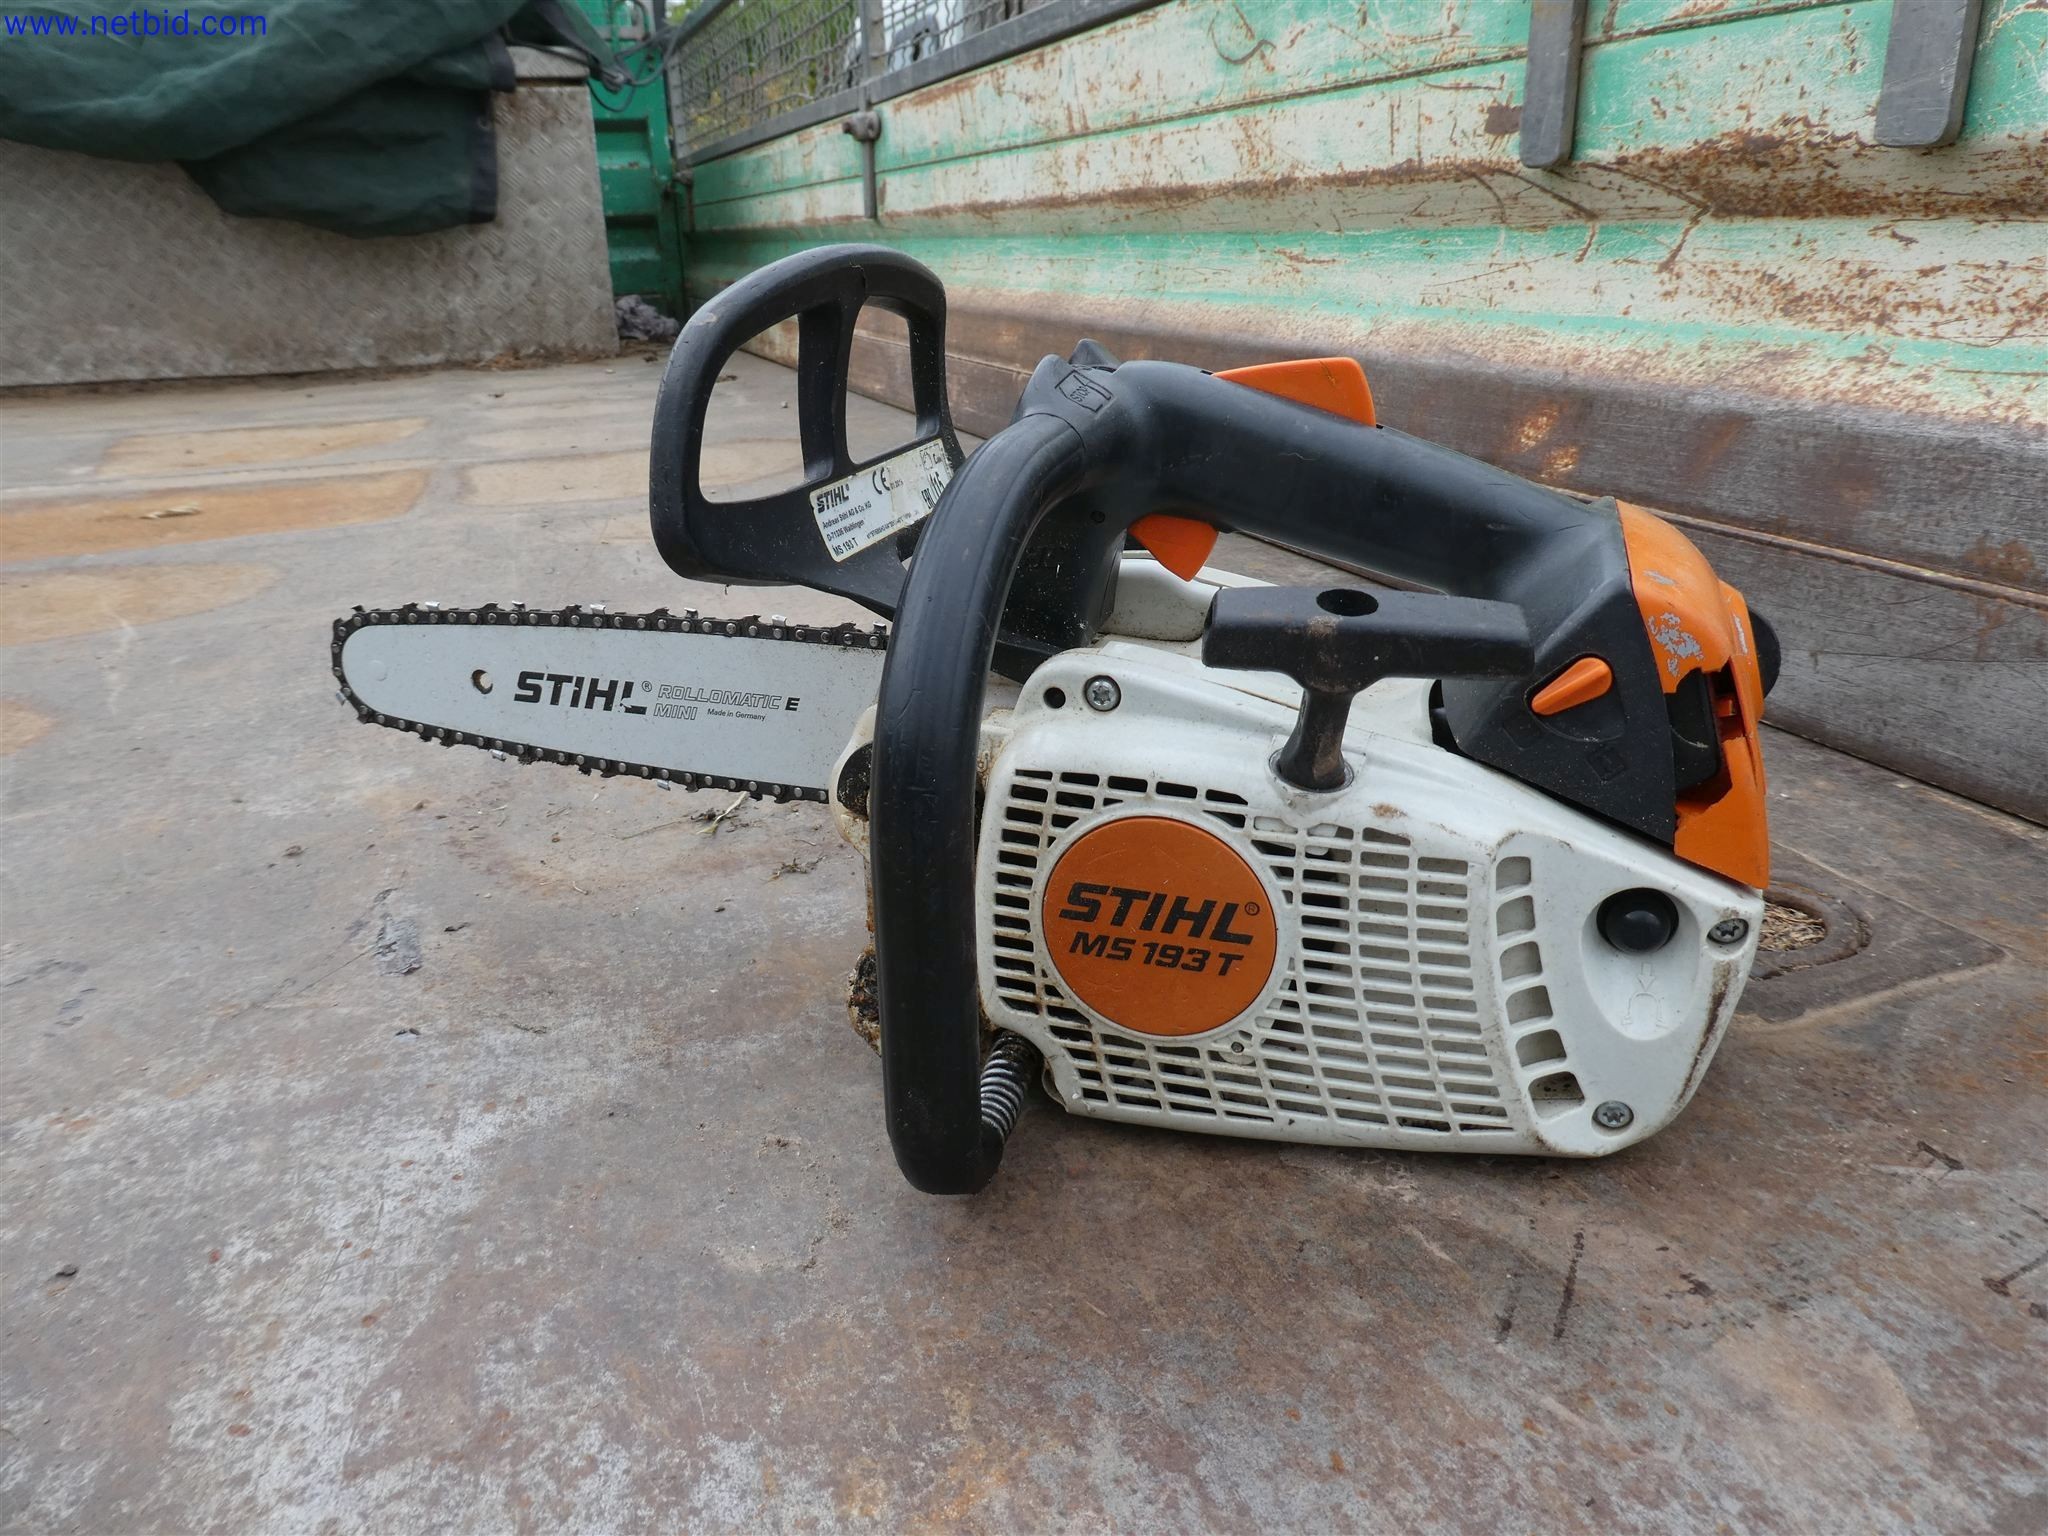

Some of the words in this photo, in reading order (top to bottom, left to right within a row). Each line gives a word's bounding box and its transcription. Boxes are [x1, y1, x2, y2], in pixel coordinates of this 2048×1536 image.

[832, 543, 844, 557] MS
[842, 539, 855, 552] 193
[851, 537, 859, 547] T
[658, 684, 783, 710] ROLLOMATIC
[785, 697, 801, 712] E
[653, 703, 698, 721] MINI
[707, 708, 727, 717] Made
[726, 710, 735, 718] in
[735, 711, 767, 722] Germany
[1069, 931, 1137, 962] MS
[1142, 942, 1212, 973] 193
[1217, 952, 1245, 977] T
